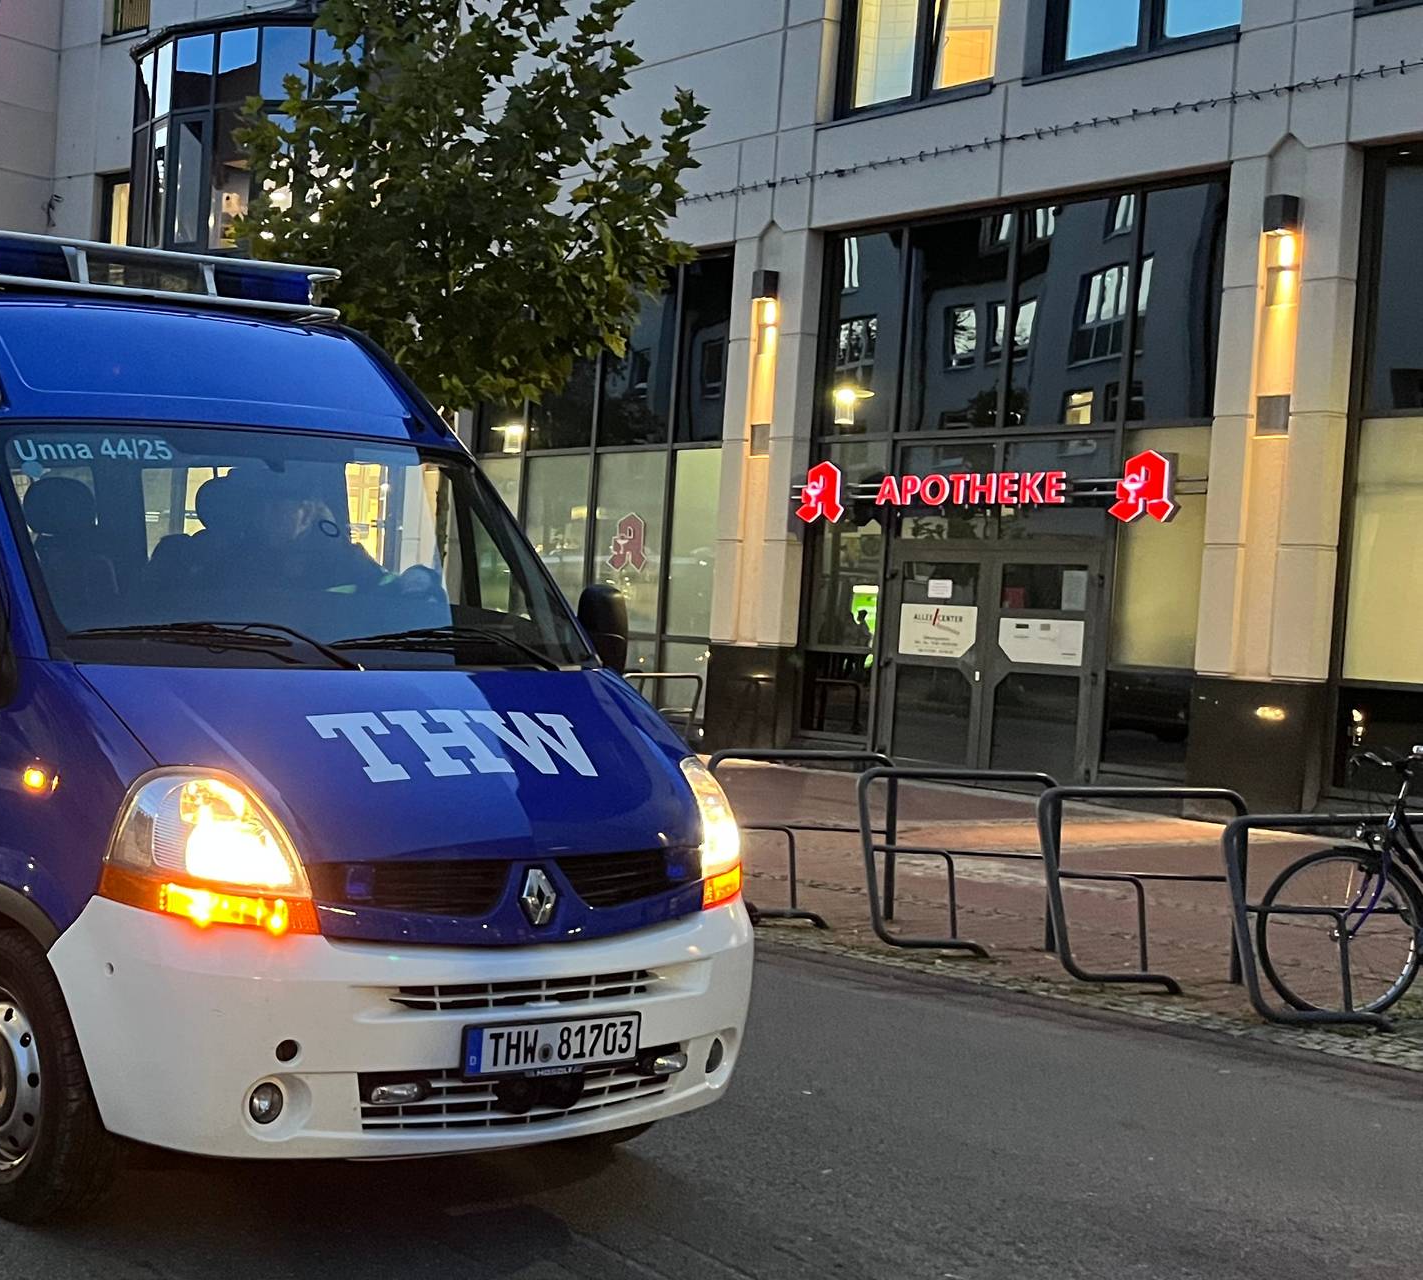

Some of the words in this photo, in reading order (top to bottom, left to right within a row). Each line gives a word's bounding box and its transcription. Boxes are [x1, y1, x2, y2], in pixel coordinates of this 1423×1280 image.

[13, 439, 94, 461] Unna
[100, 438, 173, 460] 44/25
[875, 471, 1067, 506] APOTHEKE
[938, 615, 964, 623] CENTER
[305, 709, 599, 783] THW
[469, 1055, 477, 1067] D
[489, 1029, 539, 1067] THW
[557, 1020, 634, 1061] 81703
